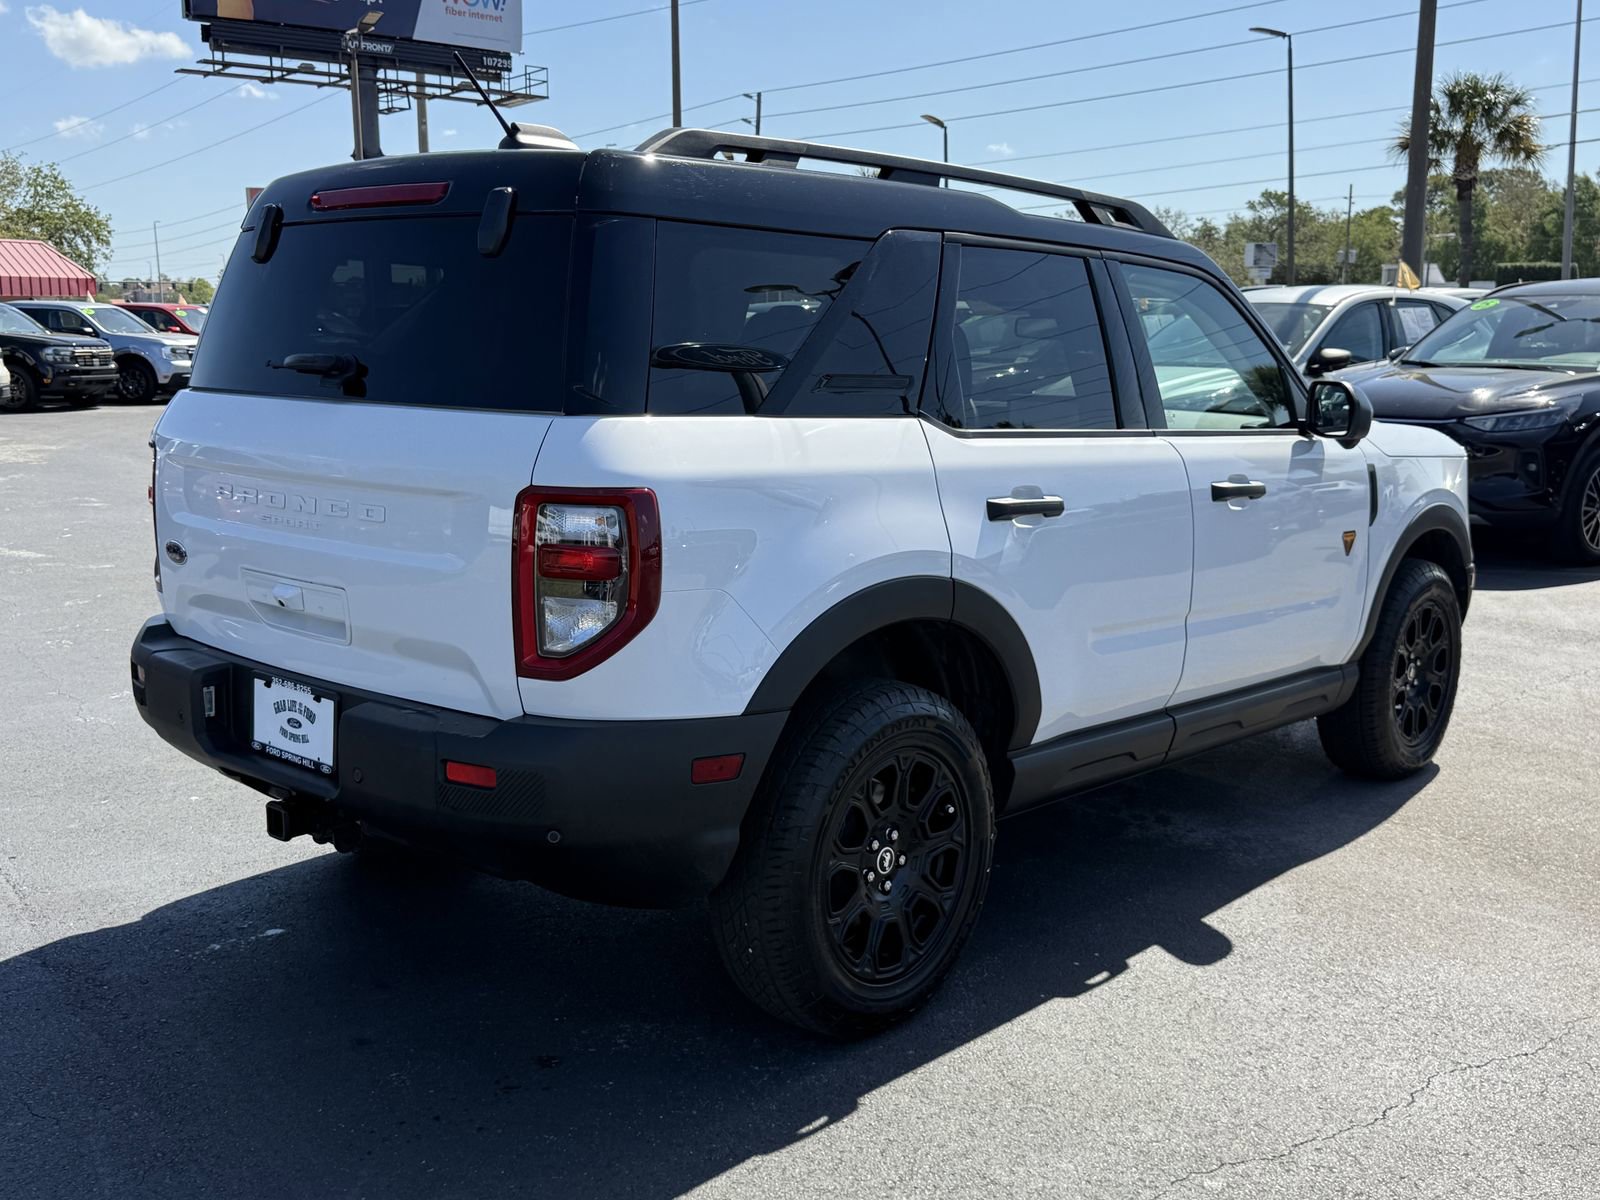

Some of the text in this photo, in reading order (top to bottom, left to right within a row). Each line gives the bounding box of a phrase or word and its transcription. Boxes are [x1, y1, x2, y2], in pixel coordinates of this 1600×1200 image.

[445, 6, 503, 23] fiber internet
[216, 482, 387, 524] BRONCO
[258, 513, 323, 531] SPORT
[265, 745, 281, 757] FORD
[281, 751, 302, 765] SPRING
[302, 757, 315, 769] HILL
